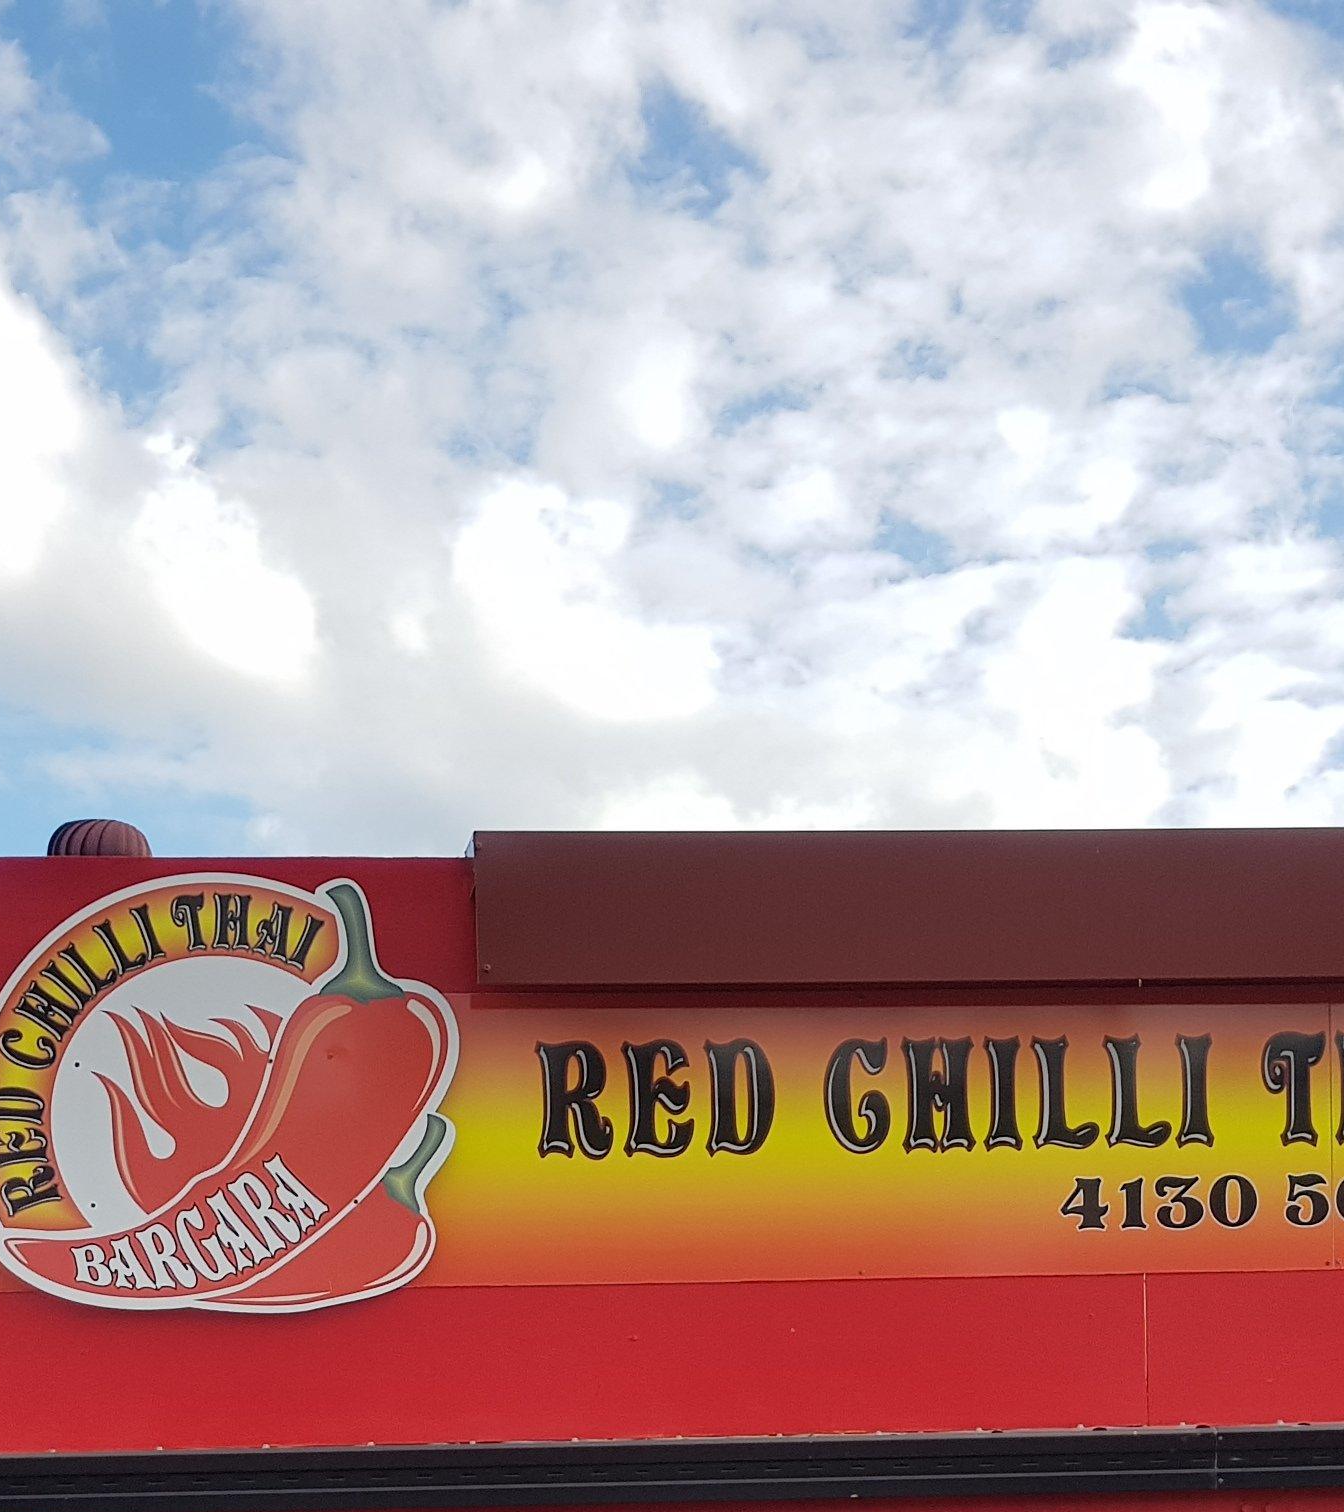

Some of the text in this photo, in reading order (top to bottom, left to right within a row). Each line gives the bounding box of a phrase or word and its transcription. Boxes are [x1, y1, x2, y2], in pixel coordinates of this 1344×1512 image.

[171, 892, 326, 971] THAI
[534, 1037, 776, 1160] RED
[822, 1031, 1215, 1155] CHILLI
[71, 1152, 330, 1290] BARGARA
[1059, 1172, 1259, 1232] 4130
